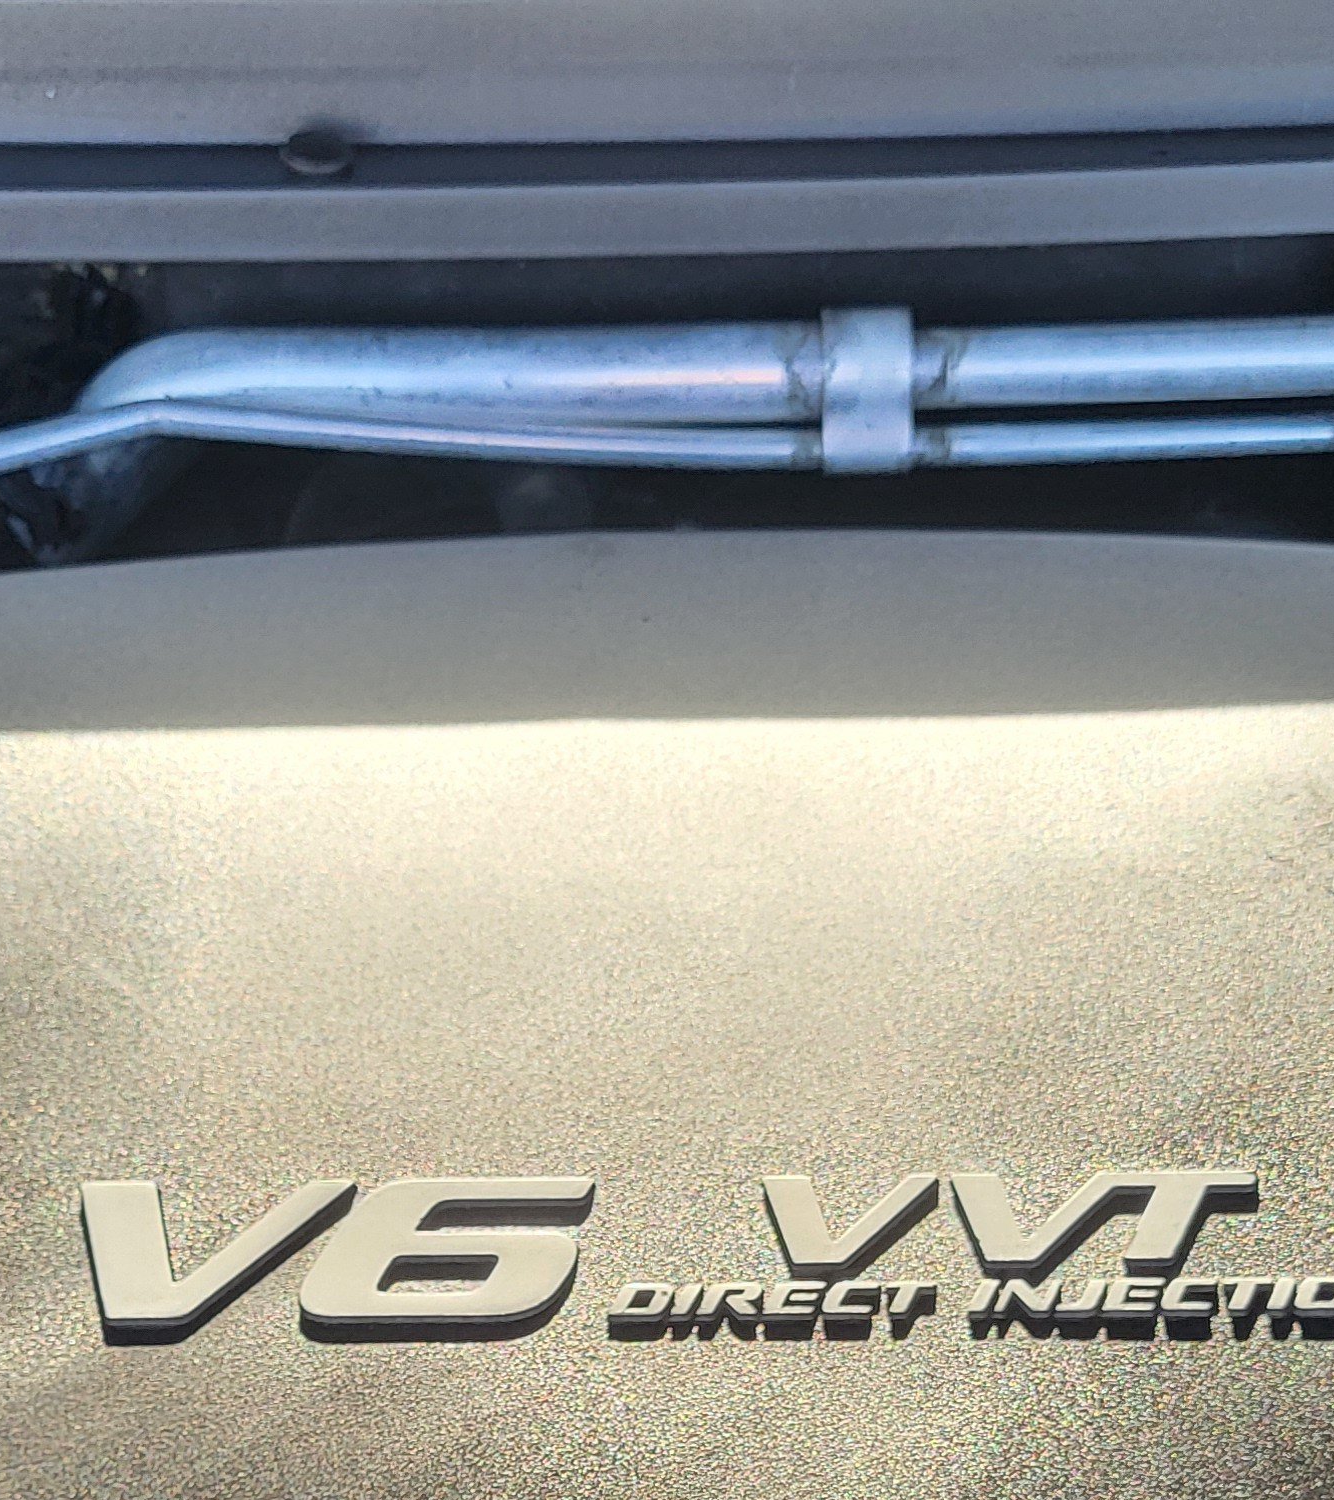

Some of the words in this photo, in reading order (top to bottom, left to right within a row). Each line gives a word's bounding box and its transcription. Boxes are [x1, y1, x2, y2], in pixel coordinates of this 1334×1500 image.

[80, 1178, 596, 1346] V6
[762, 1171, 1260, 1284] VVT
[607, 1279, 938, 1340] DIRECT
